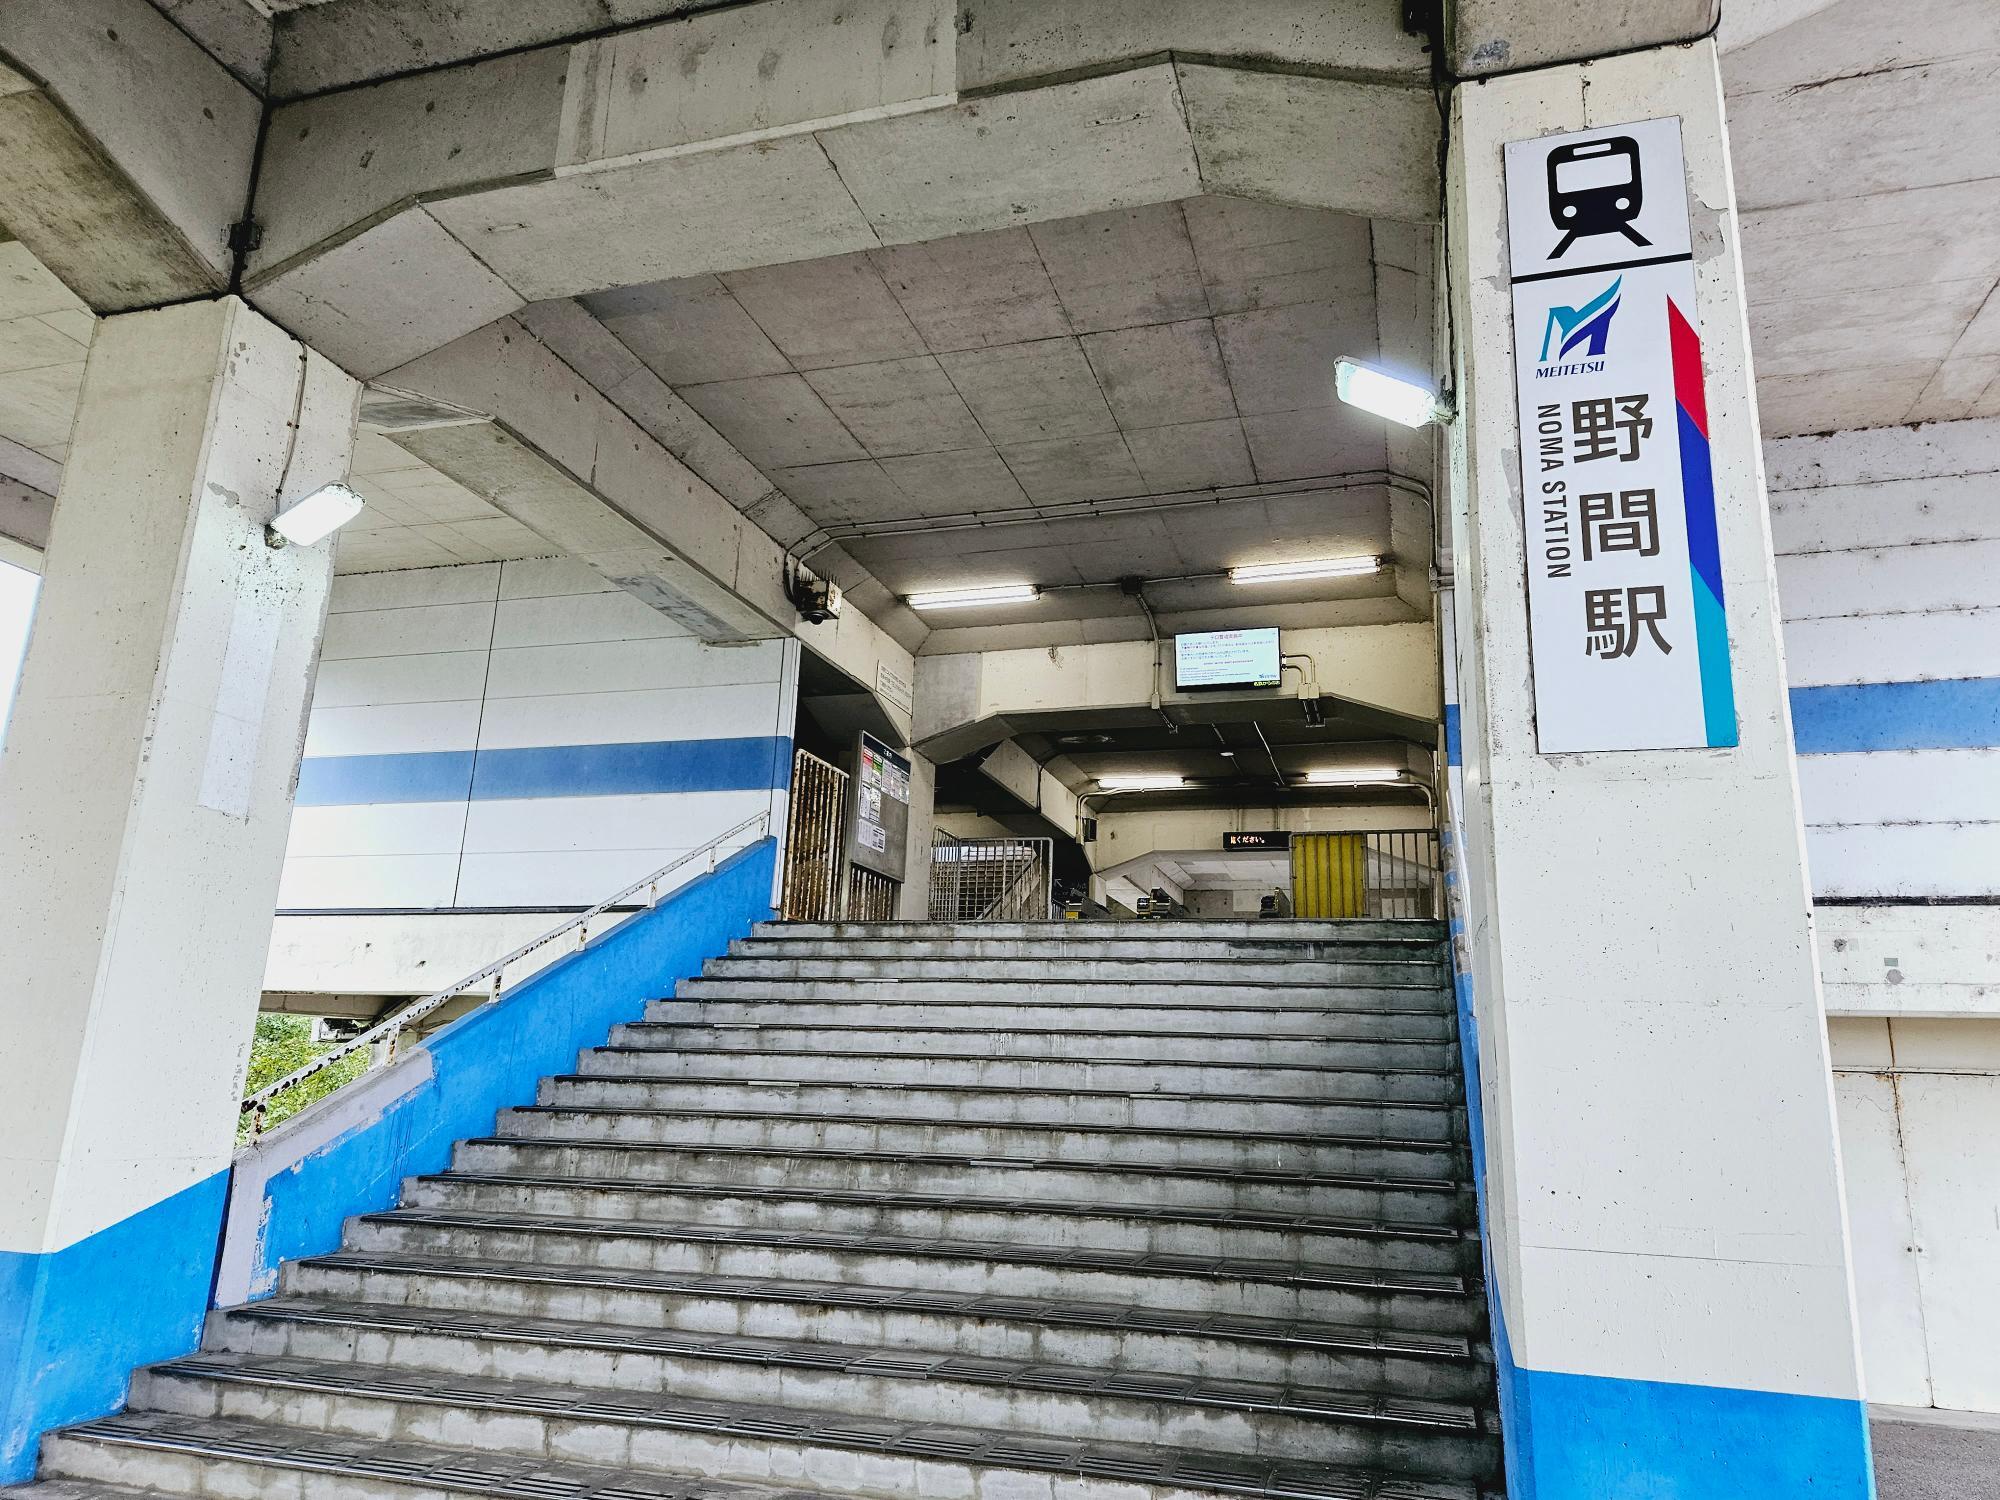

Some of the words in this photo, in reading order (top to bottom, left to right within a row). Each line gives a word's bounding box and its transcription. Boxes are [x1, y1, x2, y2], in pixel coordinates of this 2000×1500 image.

[1536, 361, 1605, 379] MEITETSU
[1538, 403, 1564, 472] NOMA
[1542, 481, 1571, 578] STATION
[1572, 394, 1672, 660] 野間駅
